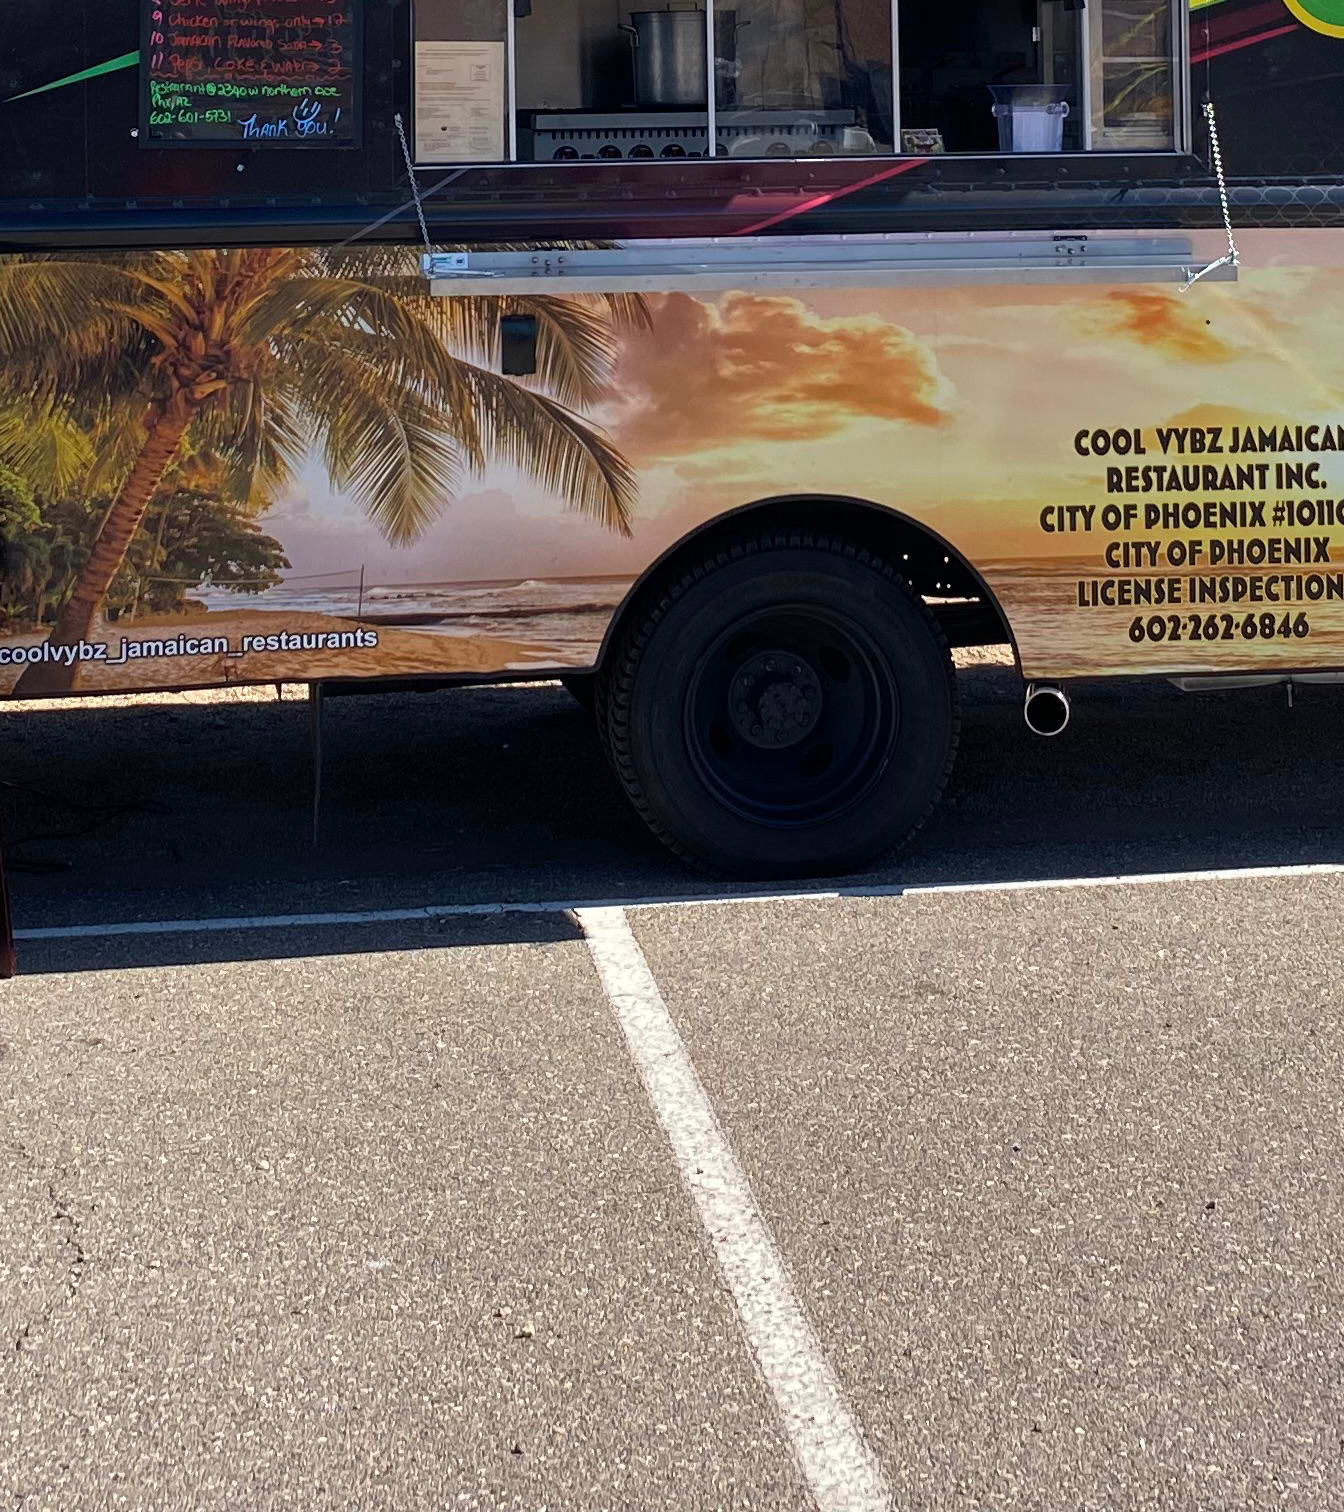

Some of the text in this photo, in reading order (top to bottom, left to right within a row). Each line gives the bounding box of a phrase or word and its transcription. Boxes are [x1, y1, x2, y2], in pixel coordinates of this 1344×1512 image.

[152, 9, 163, 27] 9
[150, 30, 164, 46] 10
[327, 38, 344, 54] 3
[149, 108, 232, 125] 602-601-5731
[1074, 428, 1146, 456] COOL
[1156, 427, 1224, 454] VYBZ
[1107, 462, 1327, 493] RESTAURANT INC.
[1040, 505, 1096, 532] CITY
[1102, 503, 1138, 531] OF
[1144, 501, 1266, 529] PHOENIX
[1105, 537, 1331, 568] CITY OF PHOENIX
[1077, 579, 1182, 607] LICENSE
[1128, 612, 1309, 642] 602-262-6846
